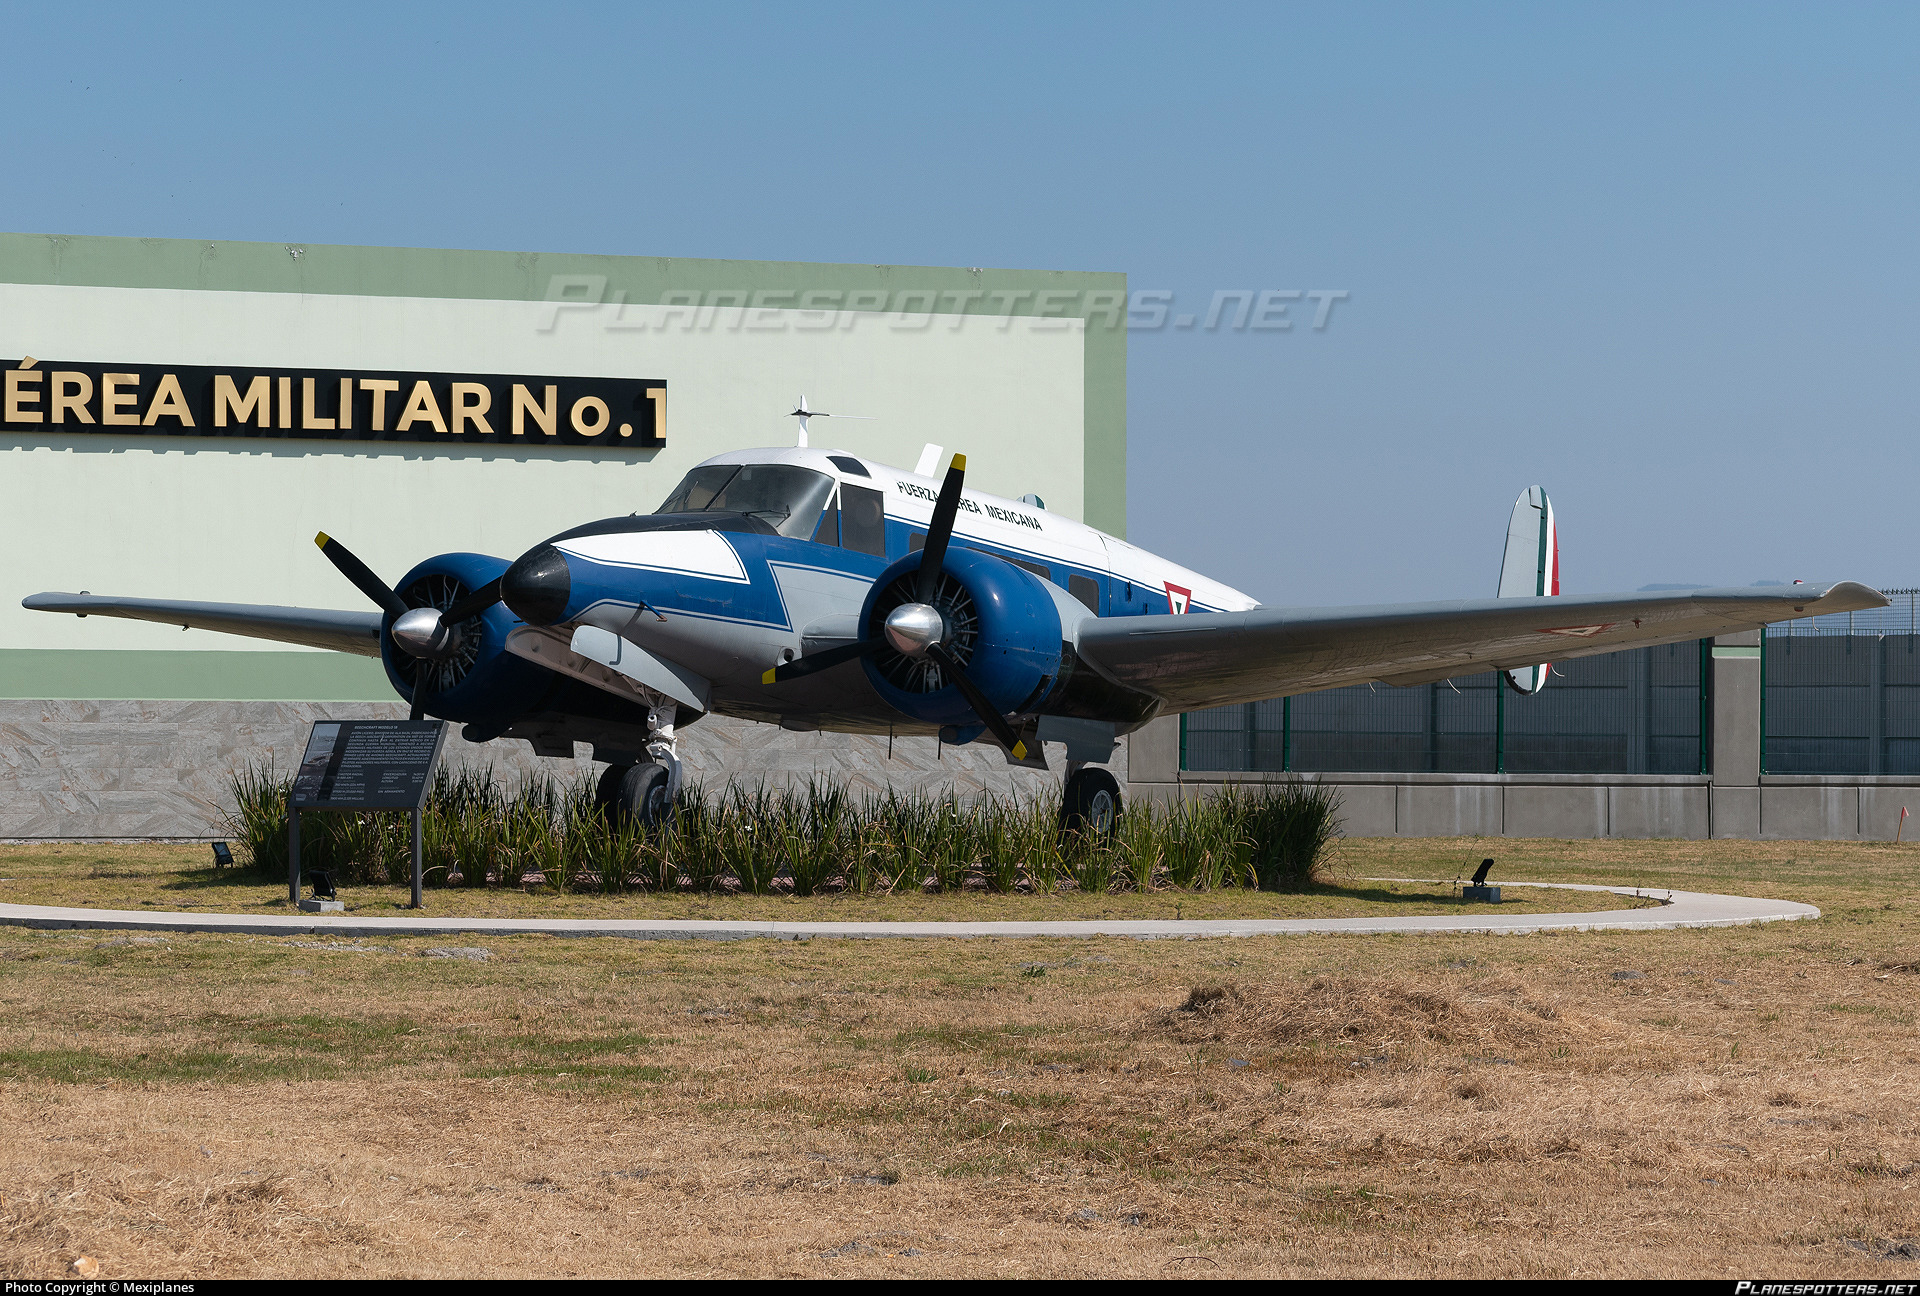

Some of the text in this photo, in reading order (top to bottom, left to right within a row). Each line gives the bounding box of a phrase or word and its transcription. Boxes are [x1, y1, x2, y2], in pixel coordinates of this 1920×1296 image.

[4, 355, 196, 427] ÉREA
[213, 374, 495, 435] MILITAR
[896, 481, 940, 502] FUERZA
[984, 504, 1043, 531] MEXICANA
